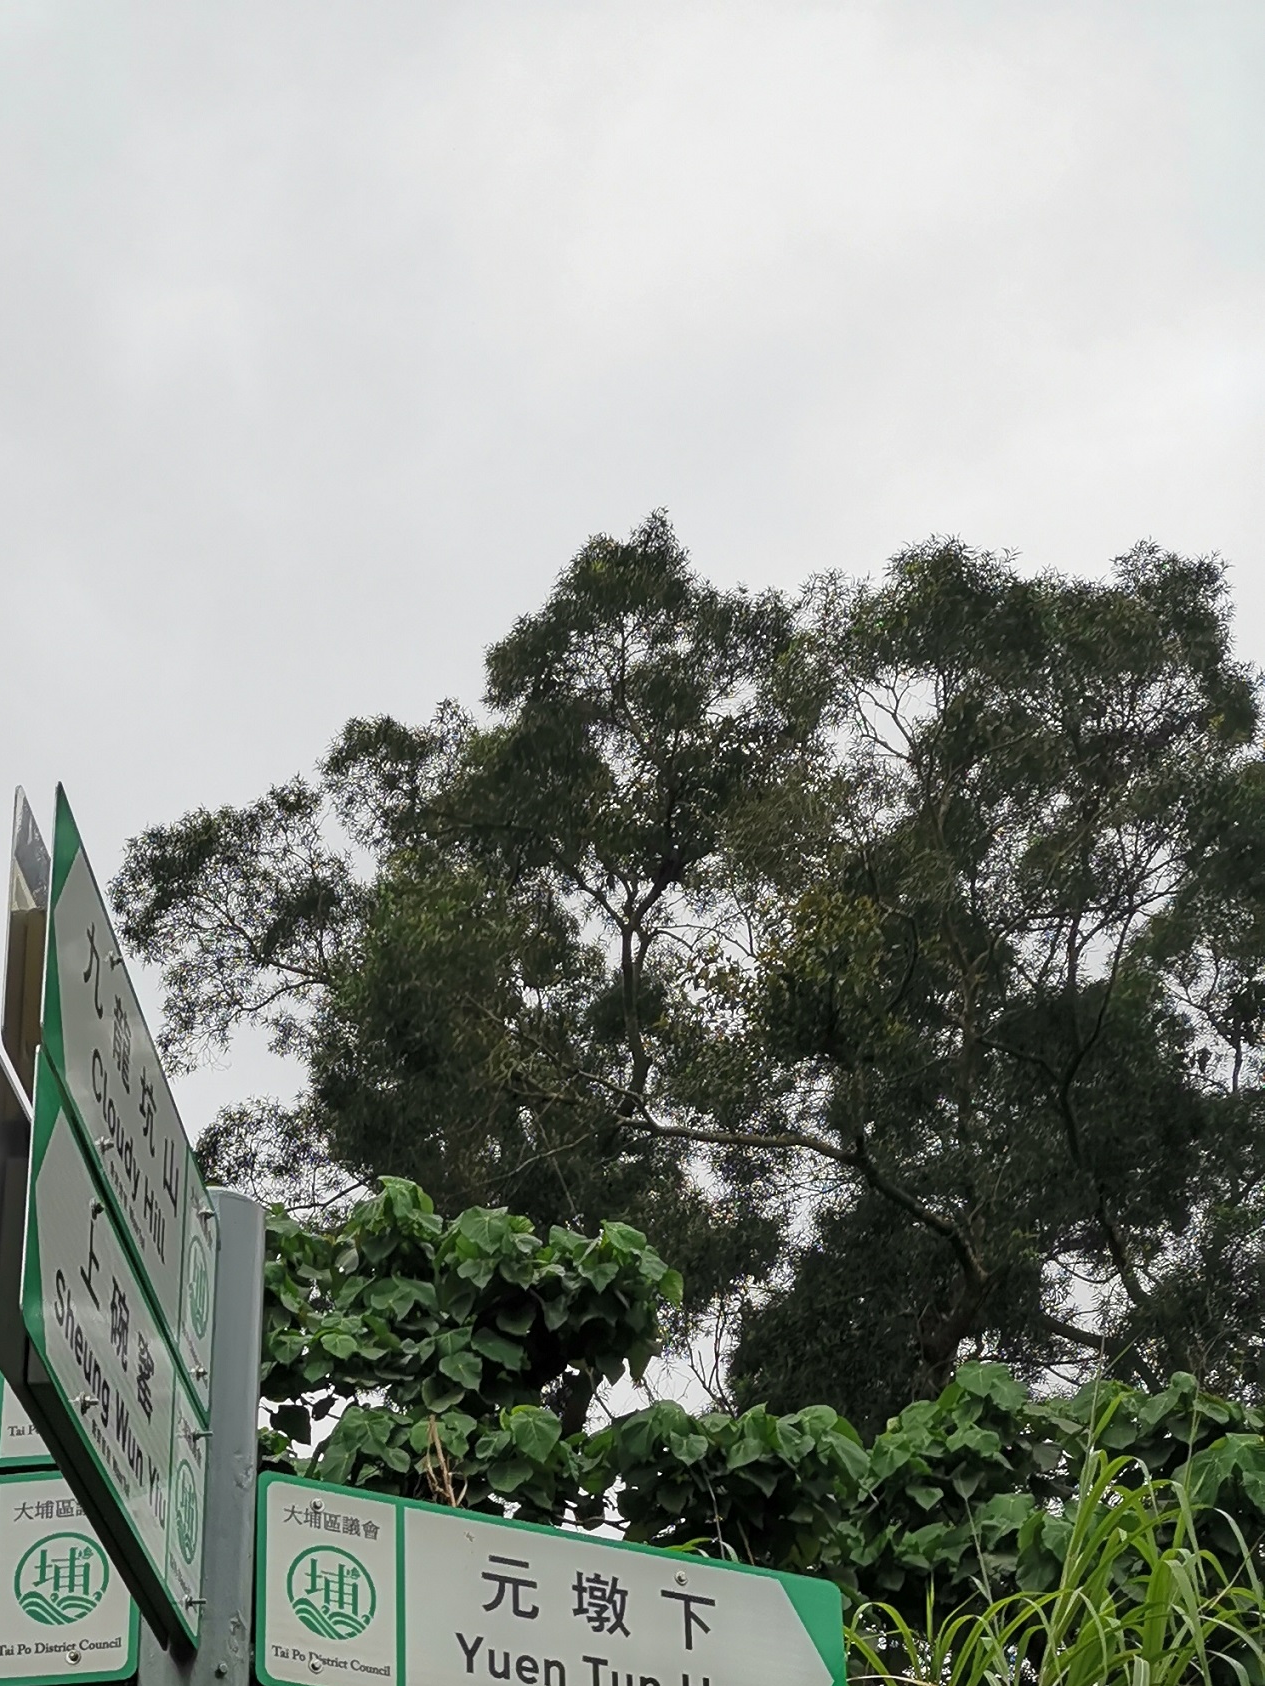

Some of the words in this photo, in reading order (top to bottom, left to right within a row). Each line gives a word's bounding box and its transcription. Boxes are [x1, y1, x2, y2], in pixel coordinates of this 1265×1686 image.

[91, 1048, 141, 1202] Cloudy
[143, 1174, 166, 1265] Hill
[55, 1268, 110, 1428] Sheung
[115, 1388, 143, 1487] Wun
[147, 1455, 166, 1531] Yiu
[7, 1425, 25, 1437] Tai
[283, 1504, 380, 1541] 大埔區議會
[481, 1554, 716, 1650] 元墩下
[17, 1643, 32, 1655] Po
[35, 1641, 76, 1654] District
[79, 1637, 122, 1651] Council
[271, 1645, 290, 1660] Tai
[292, 1649, 306, 1662] Po
[350, 1659, 391, 1677] Council
